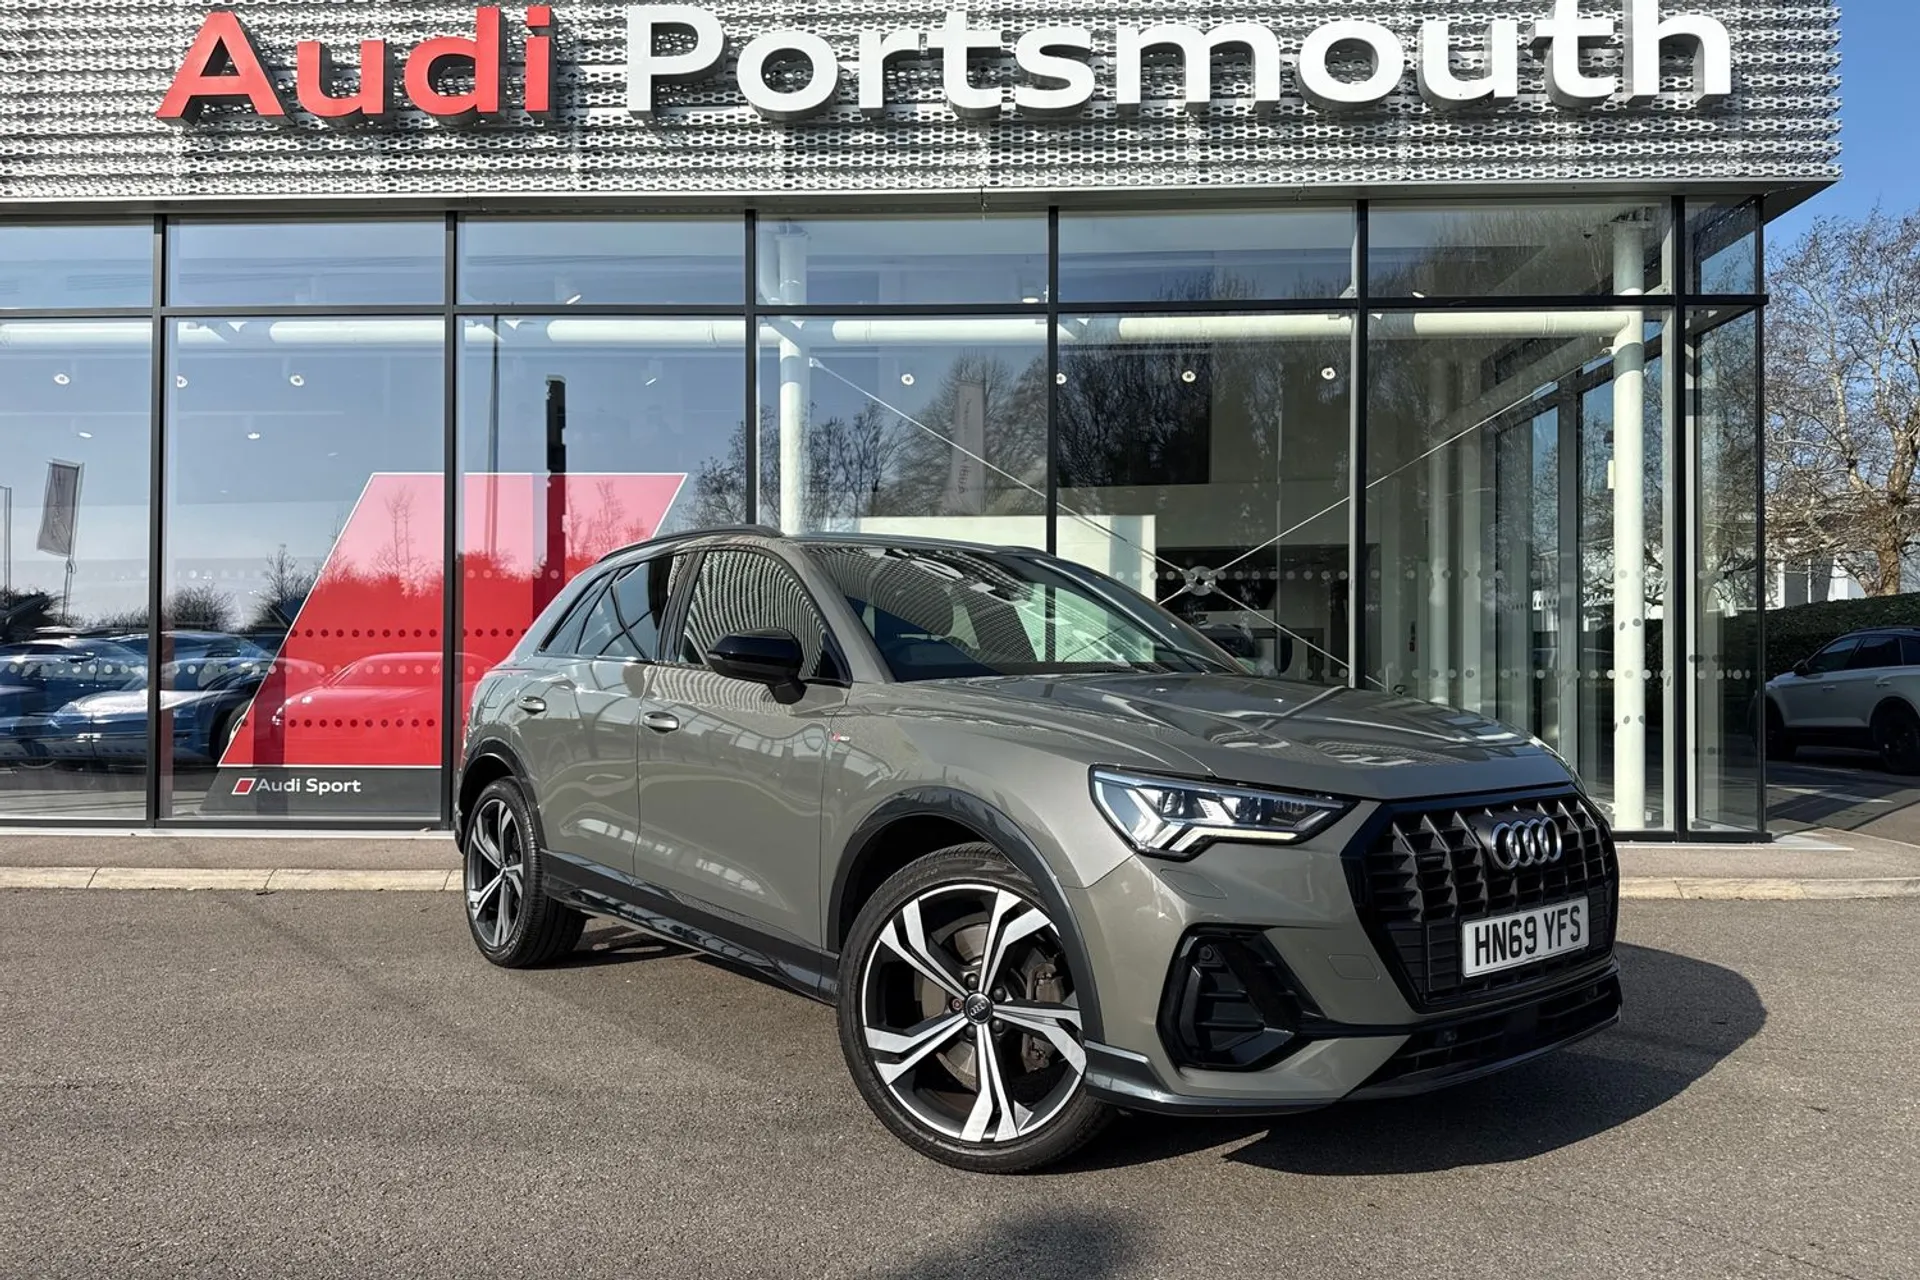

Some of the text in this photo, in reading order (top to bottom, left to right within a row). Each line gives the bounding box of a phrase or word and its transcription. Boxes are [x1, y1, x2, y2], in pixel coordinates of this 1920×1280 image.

[156, 0, 1732, 118] Audi Portsmouth
[256, 778, 361, 795] Audi Sport
[1475, 905, 1581, 966] HN69 YFS
